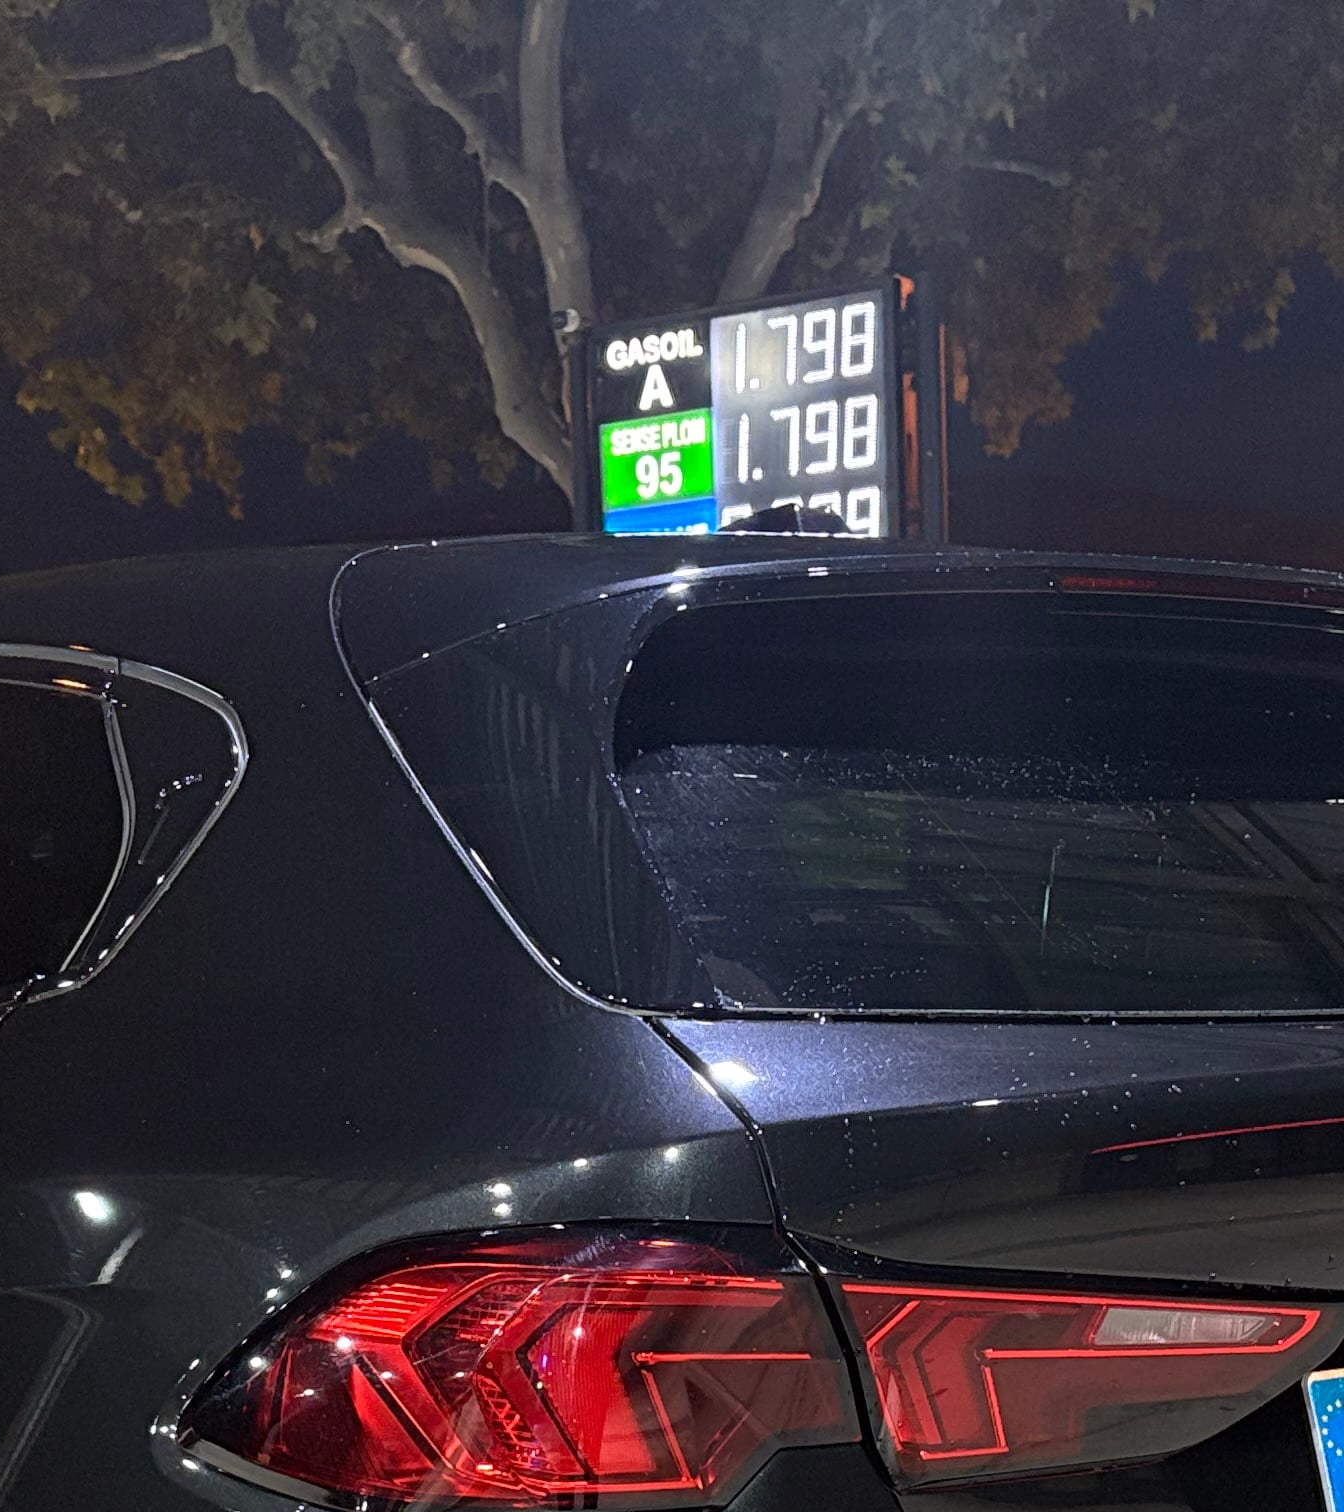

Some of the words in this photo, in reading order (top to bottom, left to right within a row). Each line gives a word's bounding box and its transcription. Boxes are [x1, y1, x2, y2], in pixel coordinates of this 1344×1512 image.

[606, 328, 704, 371] GASOIL
[736, 301, 876, 394] 1.798
[639, 363, 674, 411] A
[737, 394, 878, 484] 1.798
[635, 451, 683, 499] 95
